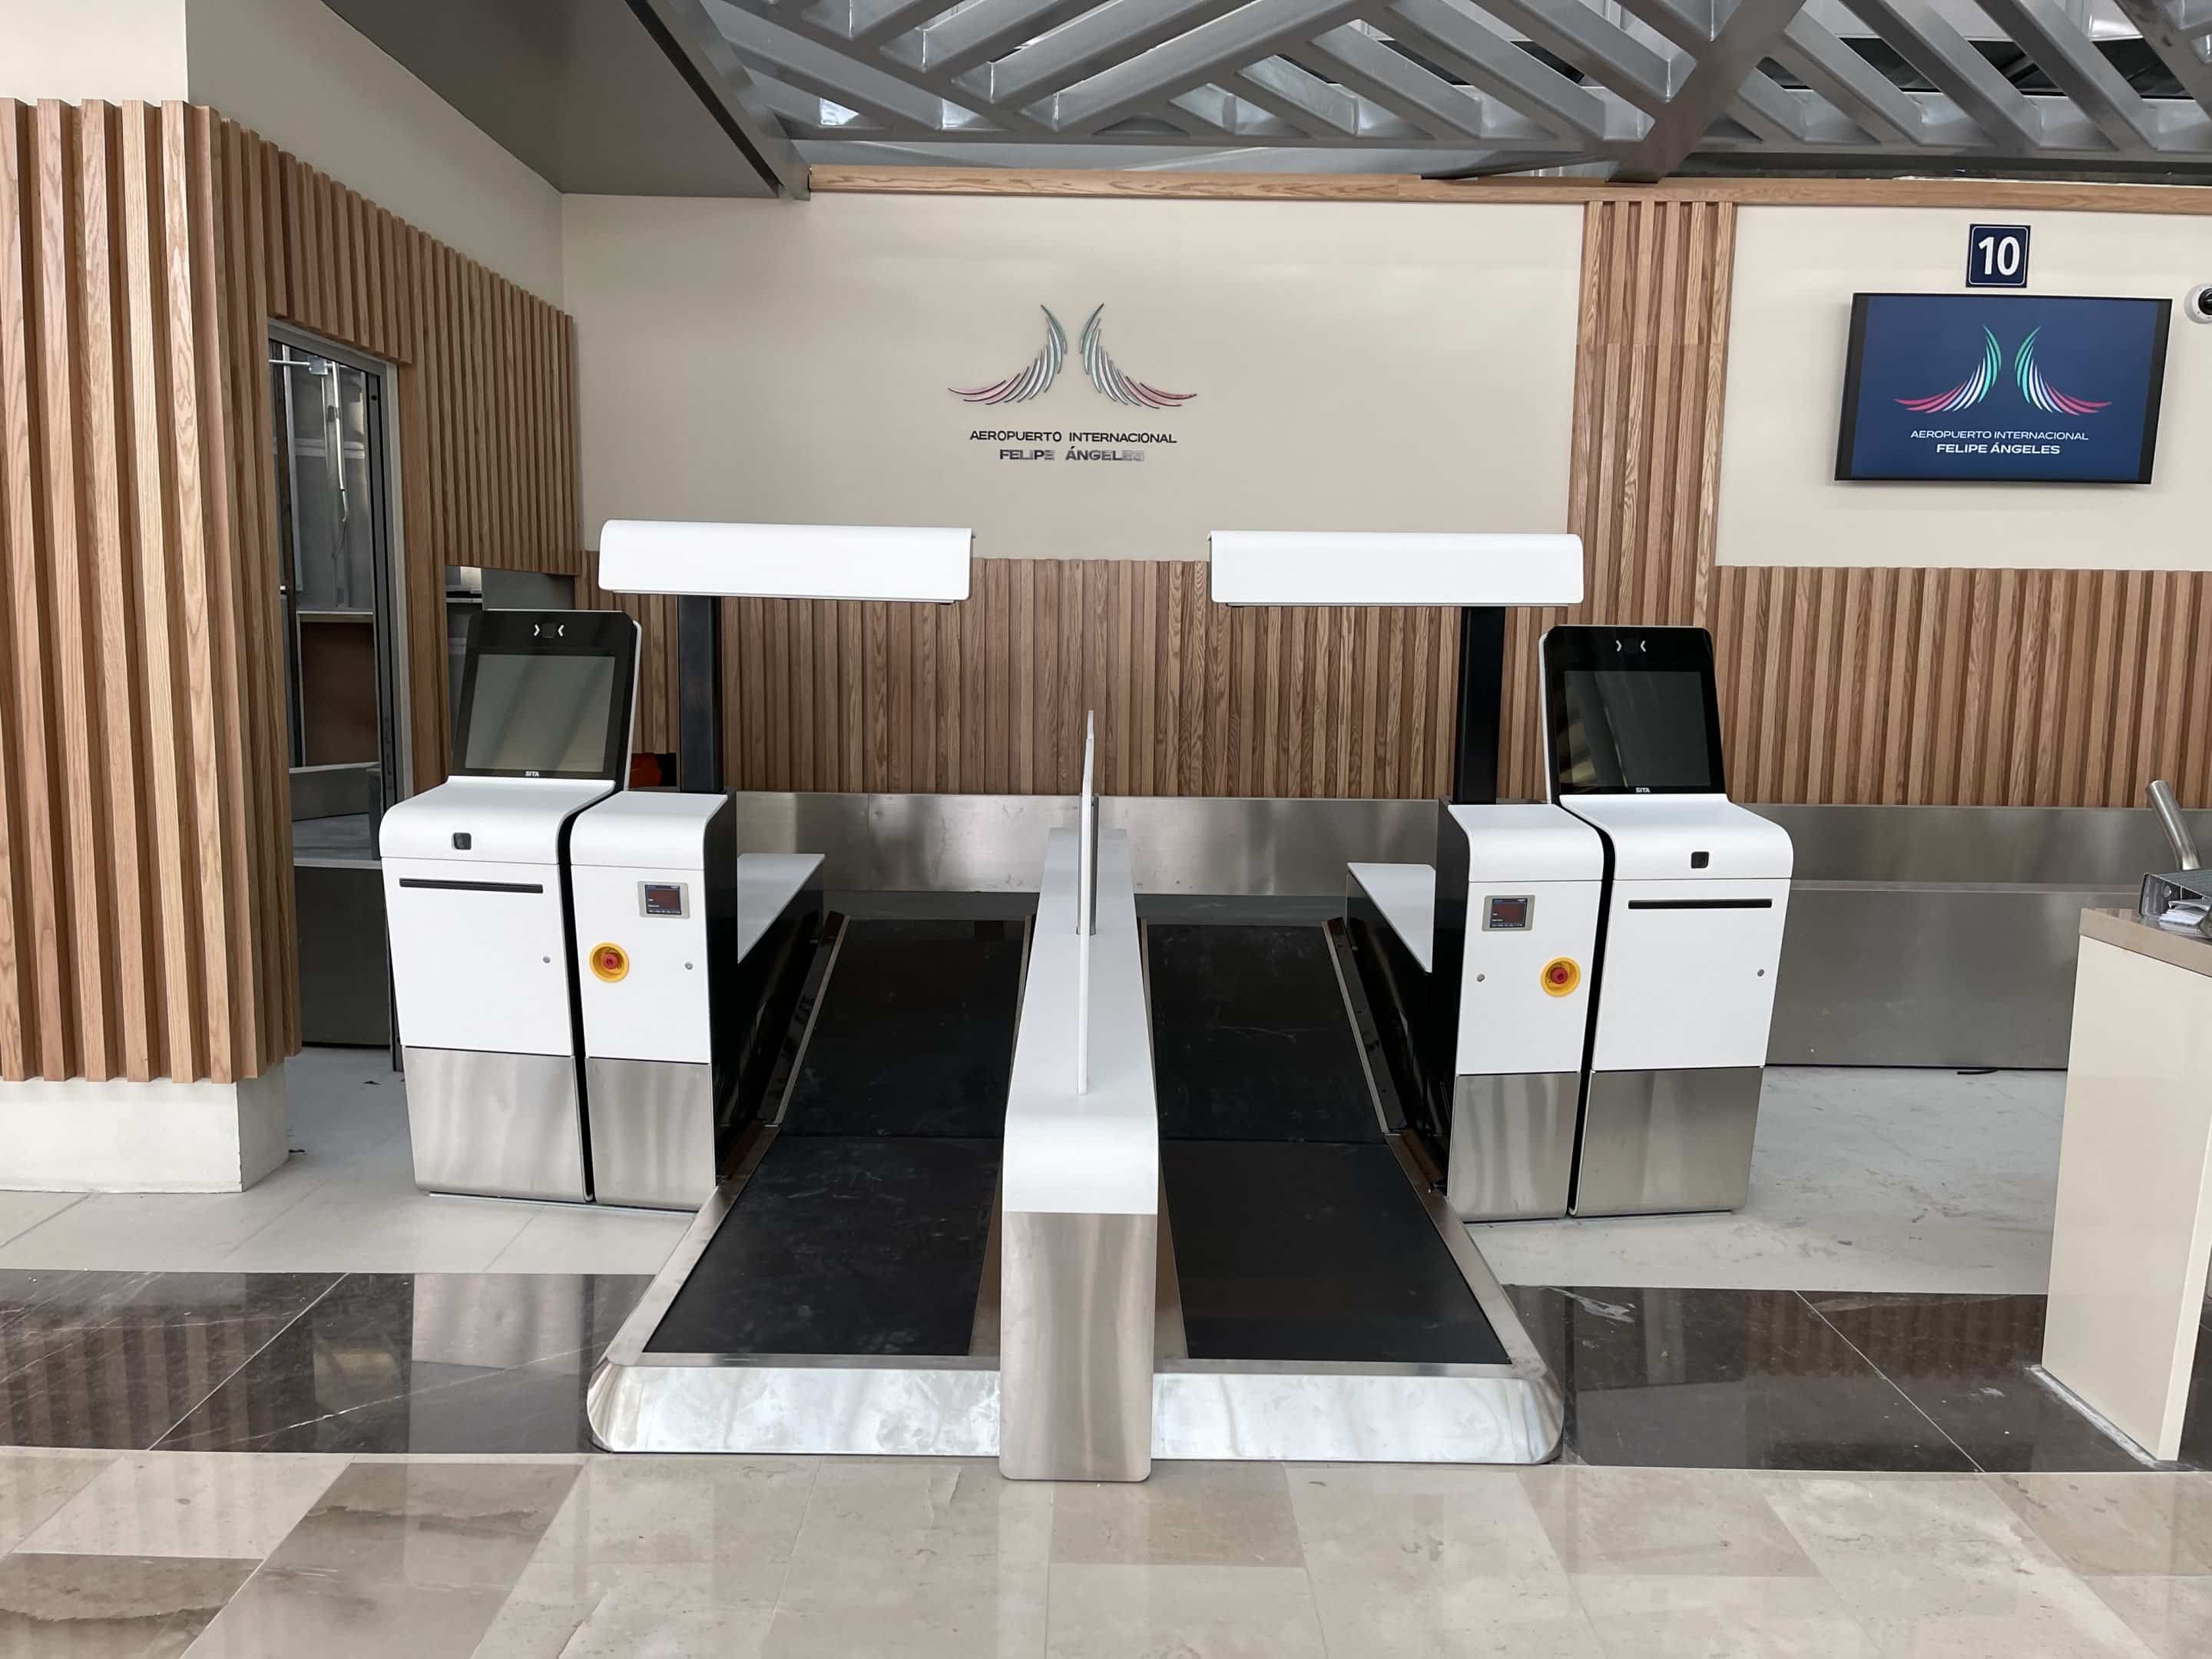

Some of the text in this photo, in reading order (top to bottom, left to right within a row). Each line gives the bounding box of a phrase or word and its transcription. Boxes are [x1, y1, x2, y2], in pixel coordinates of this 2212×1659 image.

[1978, 236, 2021, 276] 10
[969, 430, 1177, 444] AEROPUERTO INTERNACIONAL
[1910, 430, 2089, 440] AEROPUERTO INTERNACIONAL
[999, 445, 1144, 462] FELIPE ÁNGELES
[1936, 442, 2061, 455] FELIPE ÁNGELES
